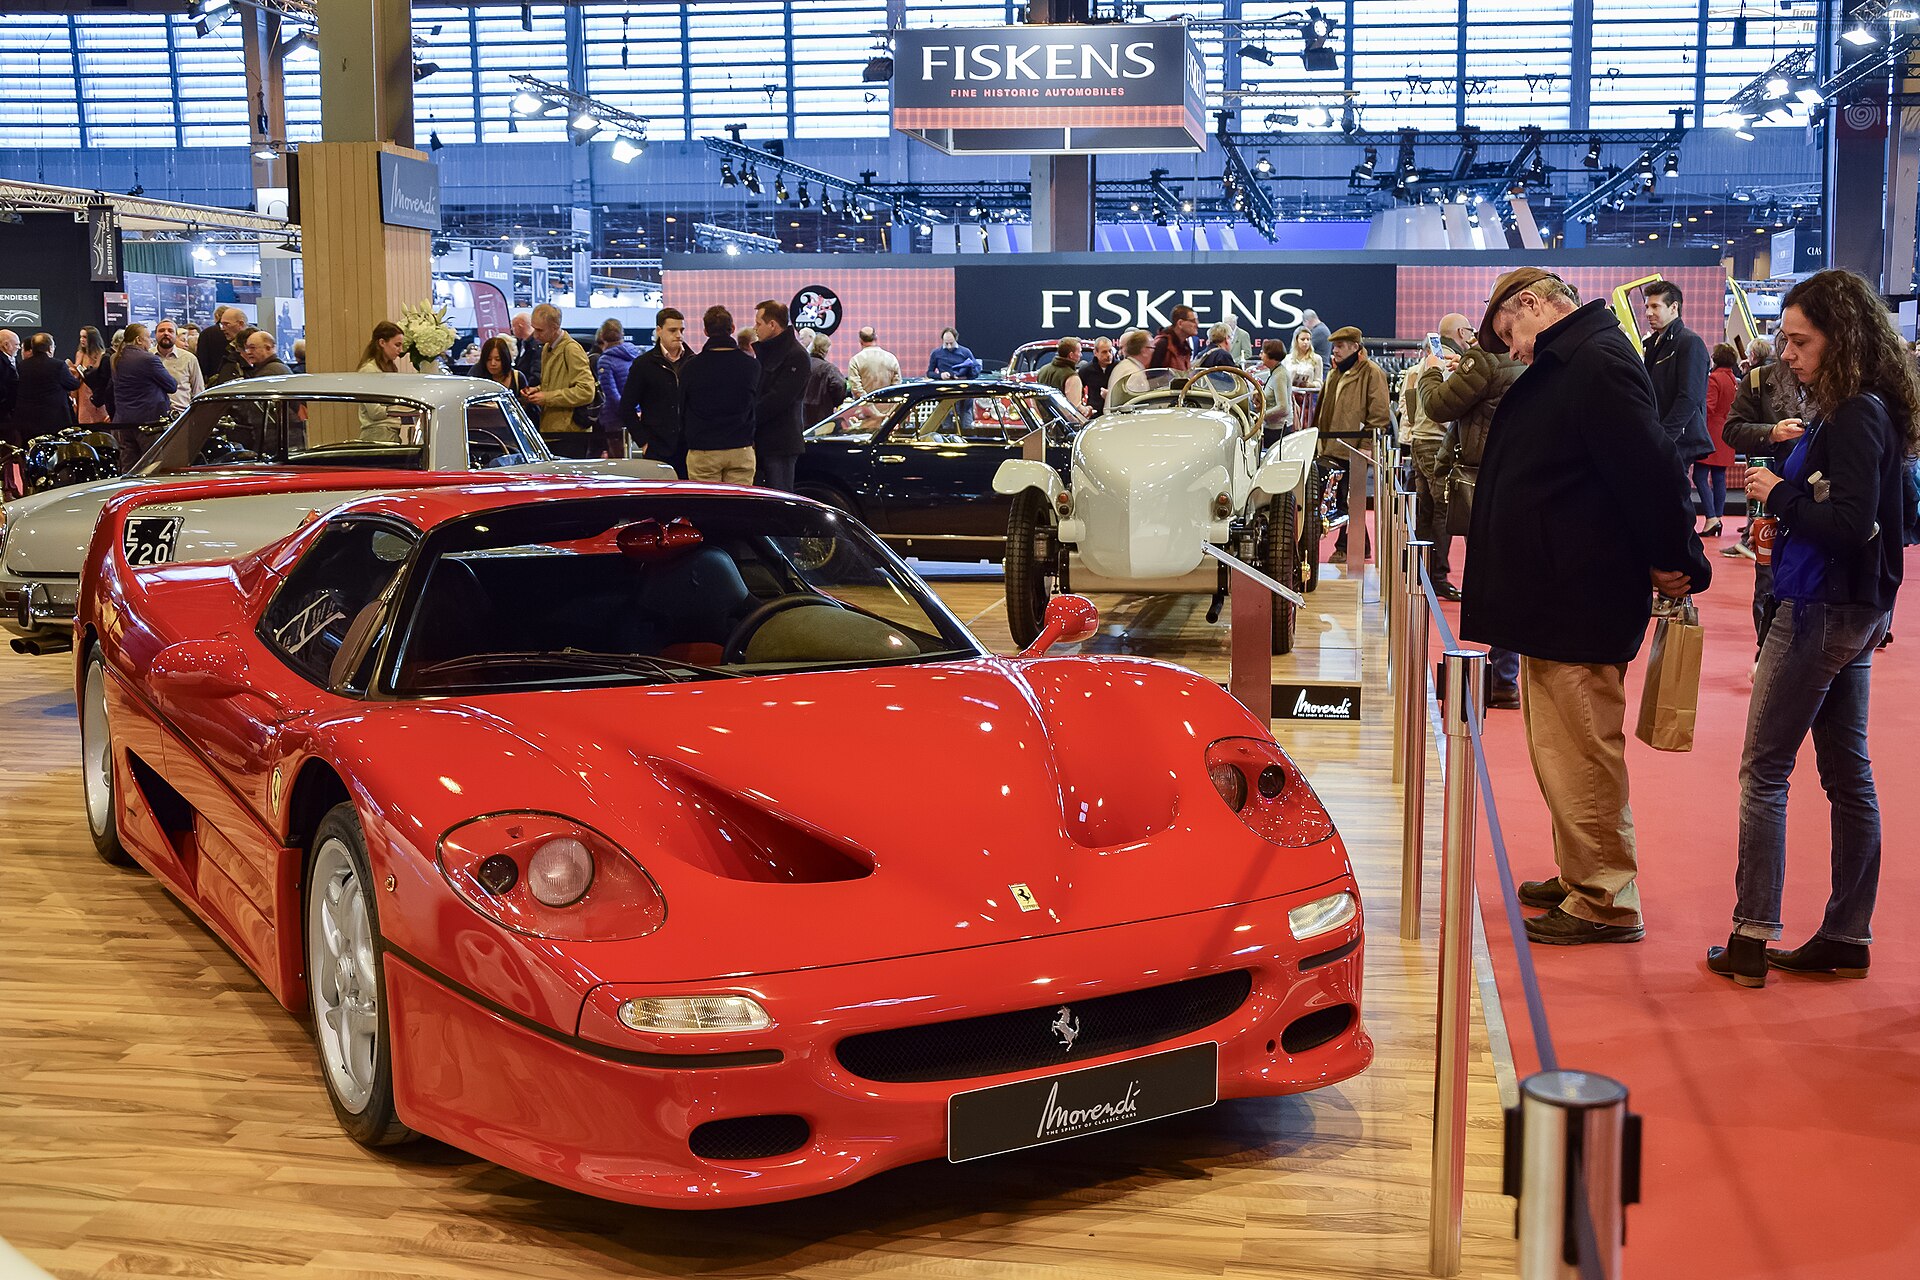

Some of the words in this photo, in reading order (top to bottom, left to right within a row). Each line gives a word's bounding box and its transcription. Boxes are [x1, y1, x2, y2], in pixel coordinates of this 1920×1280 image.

[922, 42, 1156, 81] FISKENS
[950, 89, 977, 98] FINE
[983, 88, 1040, 98] HISTORIC
[1045, 87, 1125, 97] AUTOMOBILES
[1041, 288, 1303, 329] FISKENS
[158, 520, 171, 542] 4
[125, 542, 169, 565] 720
[1292, 688, 1352, 716] Movendi
[1036, 1081, 1141, 1139] Movendi
[1061, 1124, 1082, 1133] SPIRIT
[1094, 1115, 1119, 1126] CLASSIC
[1121, 1112, 1137, 1120] CARS
